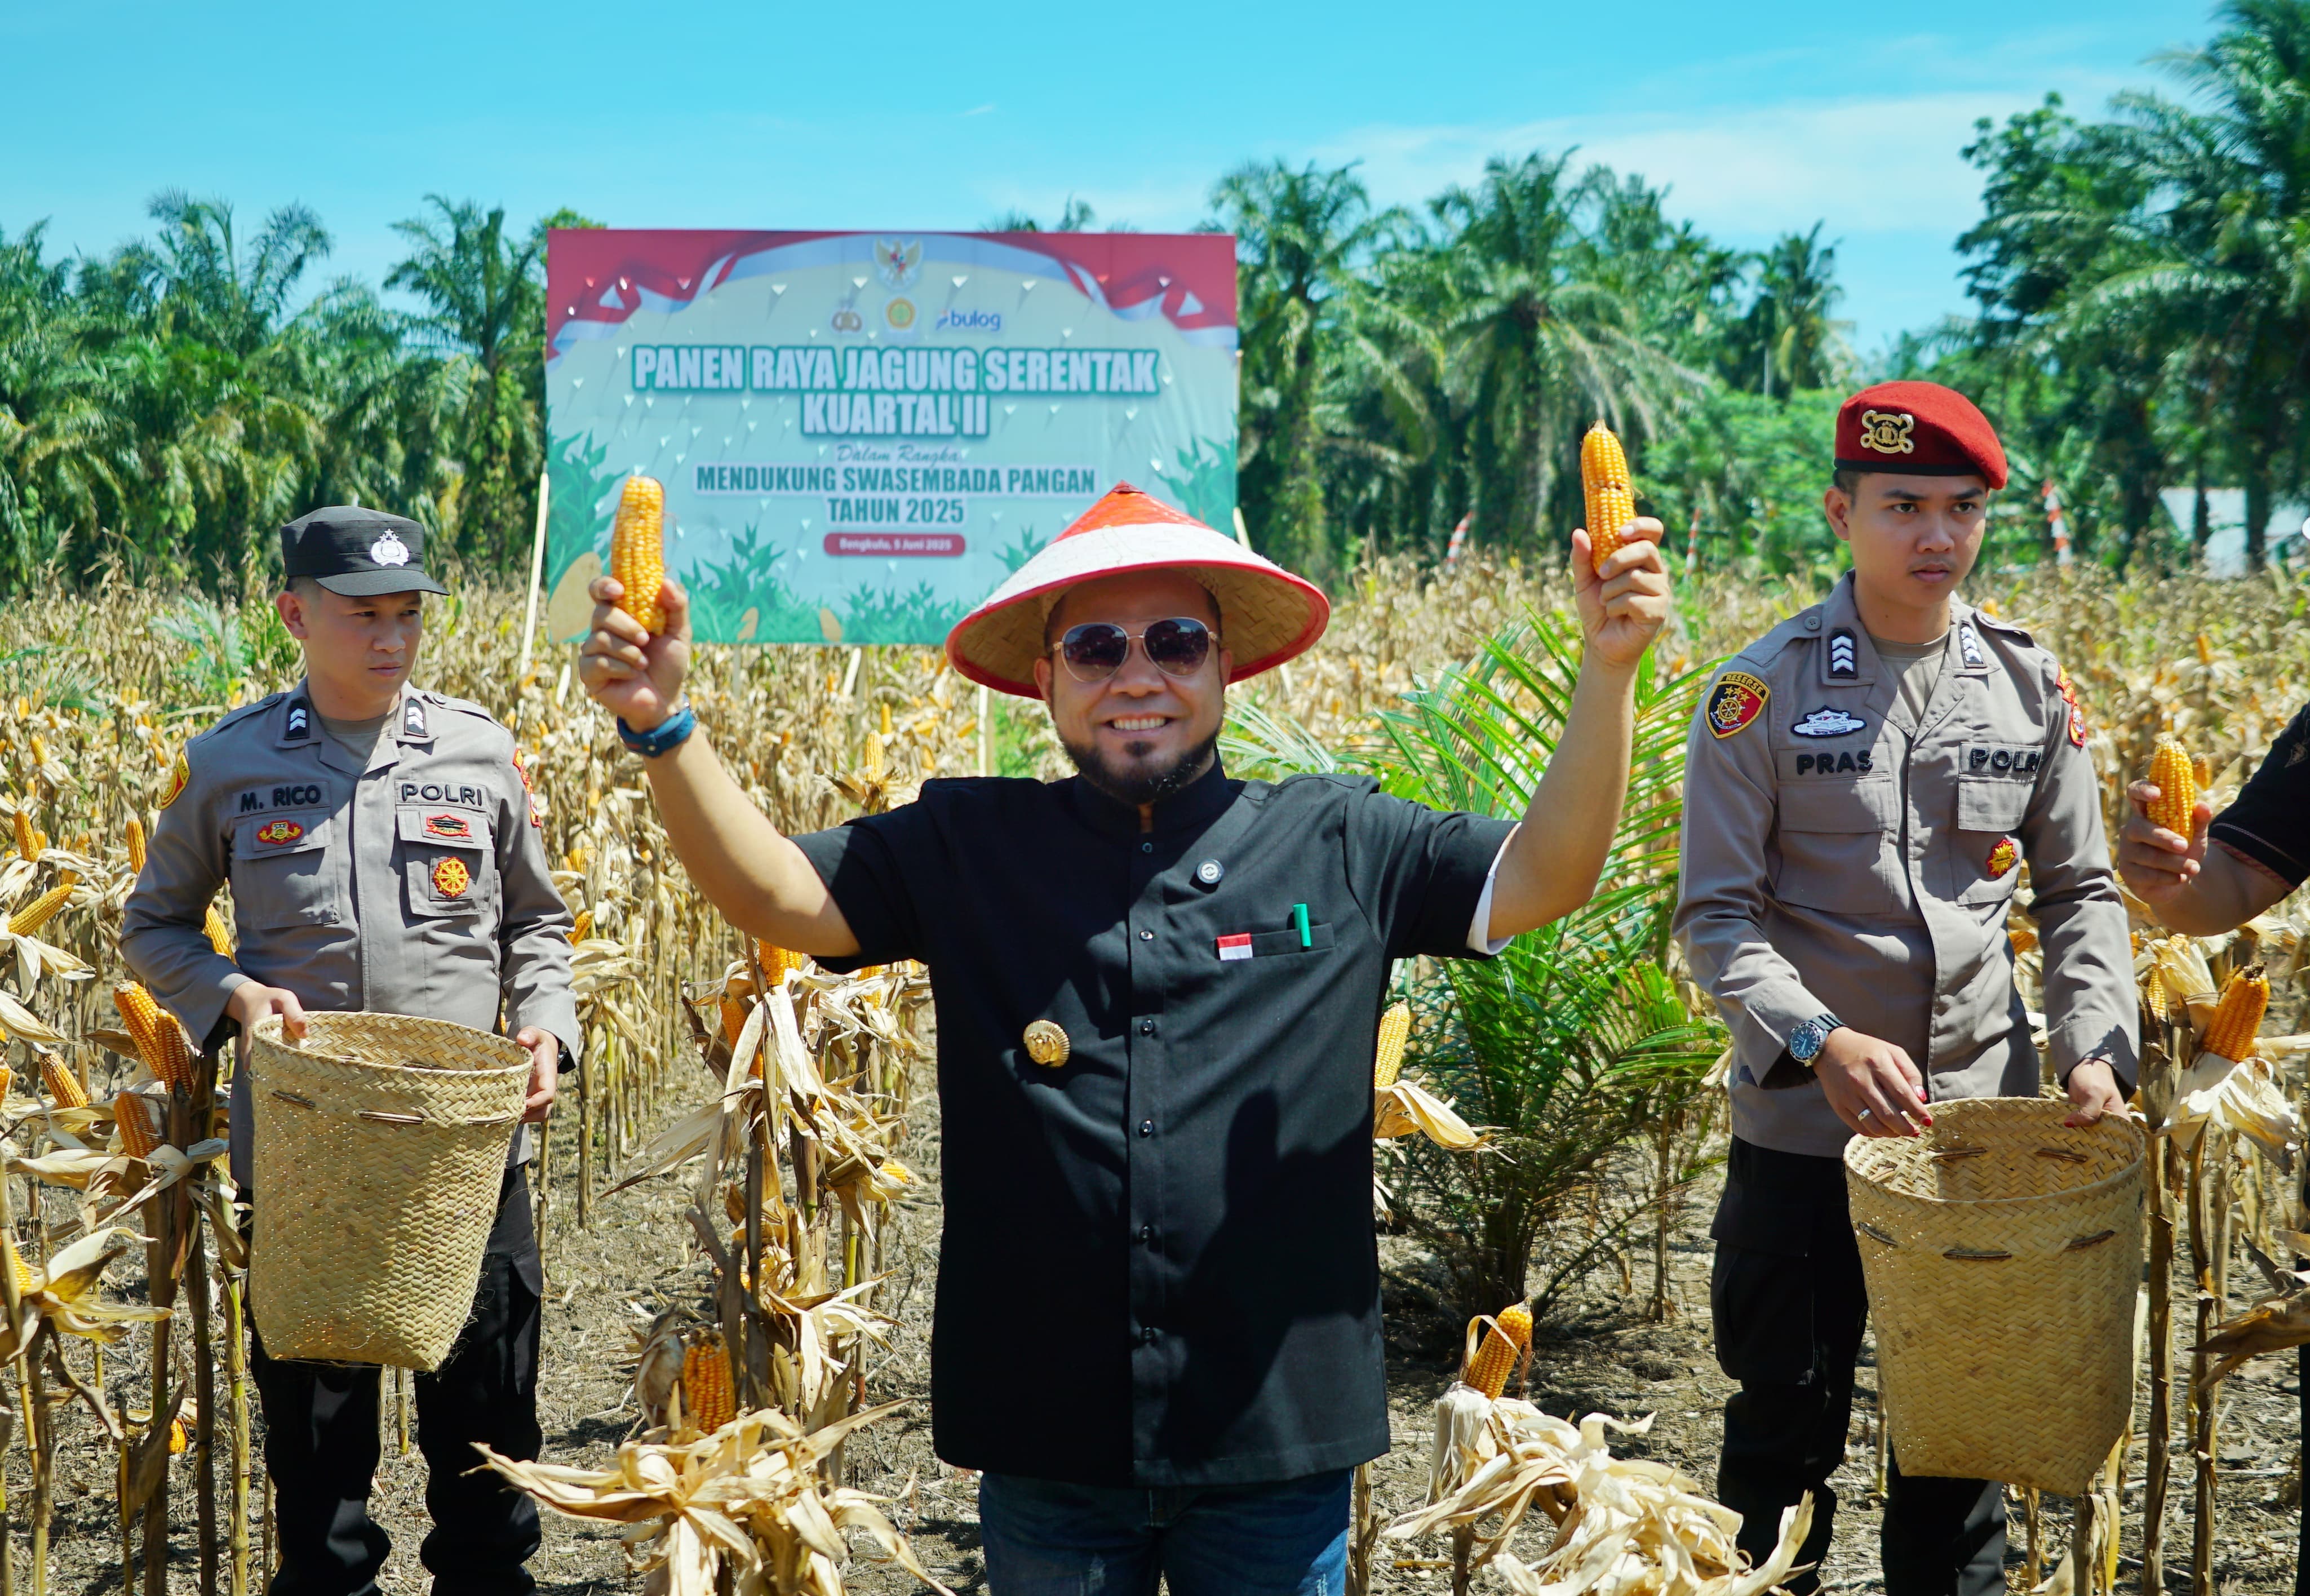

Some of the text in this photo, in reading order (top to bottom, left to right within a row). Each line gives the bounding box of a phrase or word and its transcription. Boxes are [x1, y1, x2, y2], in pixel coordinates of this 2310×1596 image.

[951, 309, 1001, 331] bulog
[634, 347, 1158, 393] PANEN RAYA JAGUNG SERENTAK
[802, 393, 988, 435] KUARTAL II
[837, 443, 958, 468] Dalam Rangka
[696, 466, 1095, 493] MENDUKUNG SWASEMBADA PANGAN
[827, 498, 964, 524] TAHUN 2025
[1726, 674, 1762, 695] RESERSE
[1796, 750, 1873, 775] PRAS
[240, 784, 321, 813] M. RICO
[402, 783, 483, 806] POLRI
